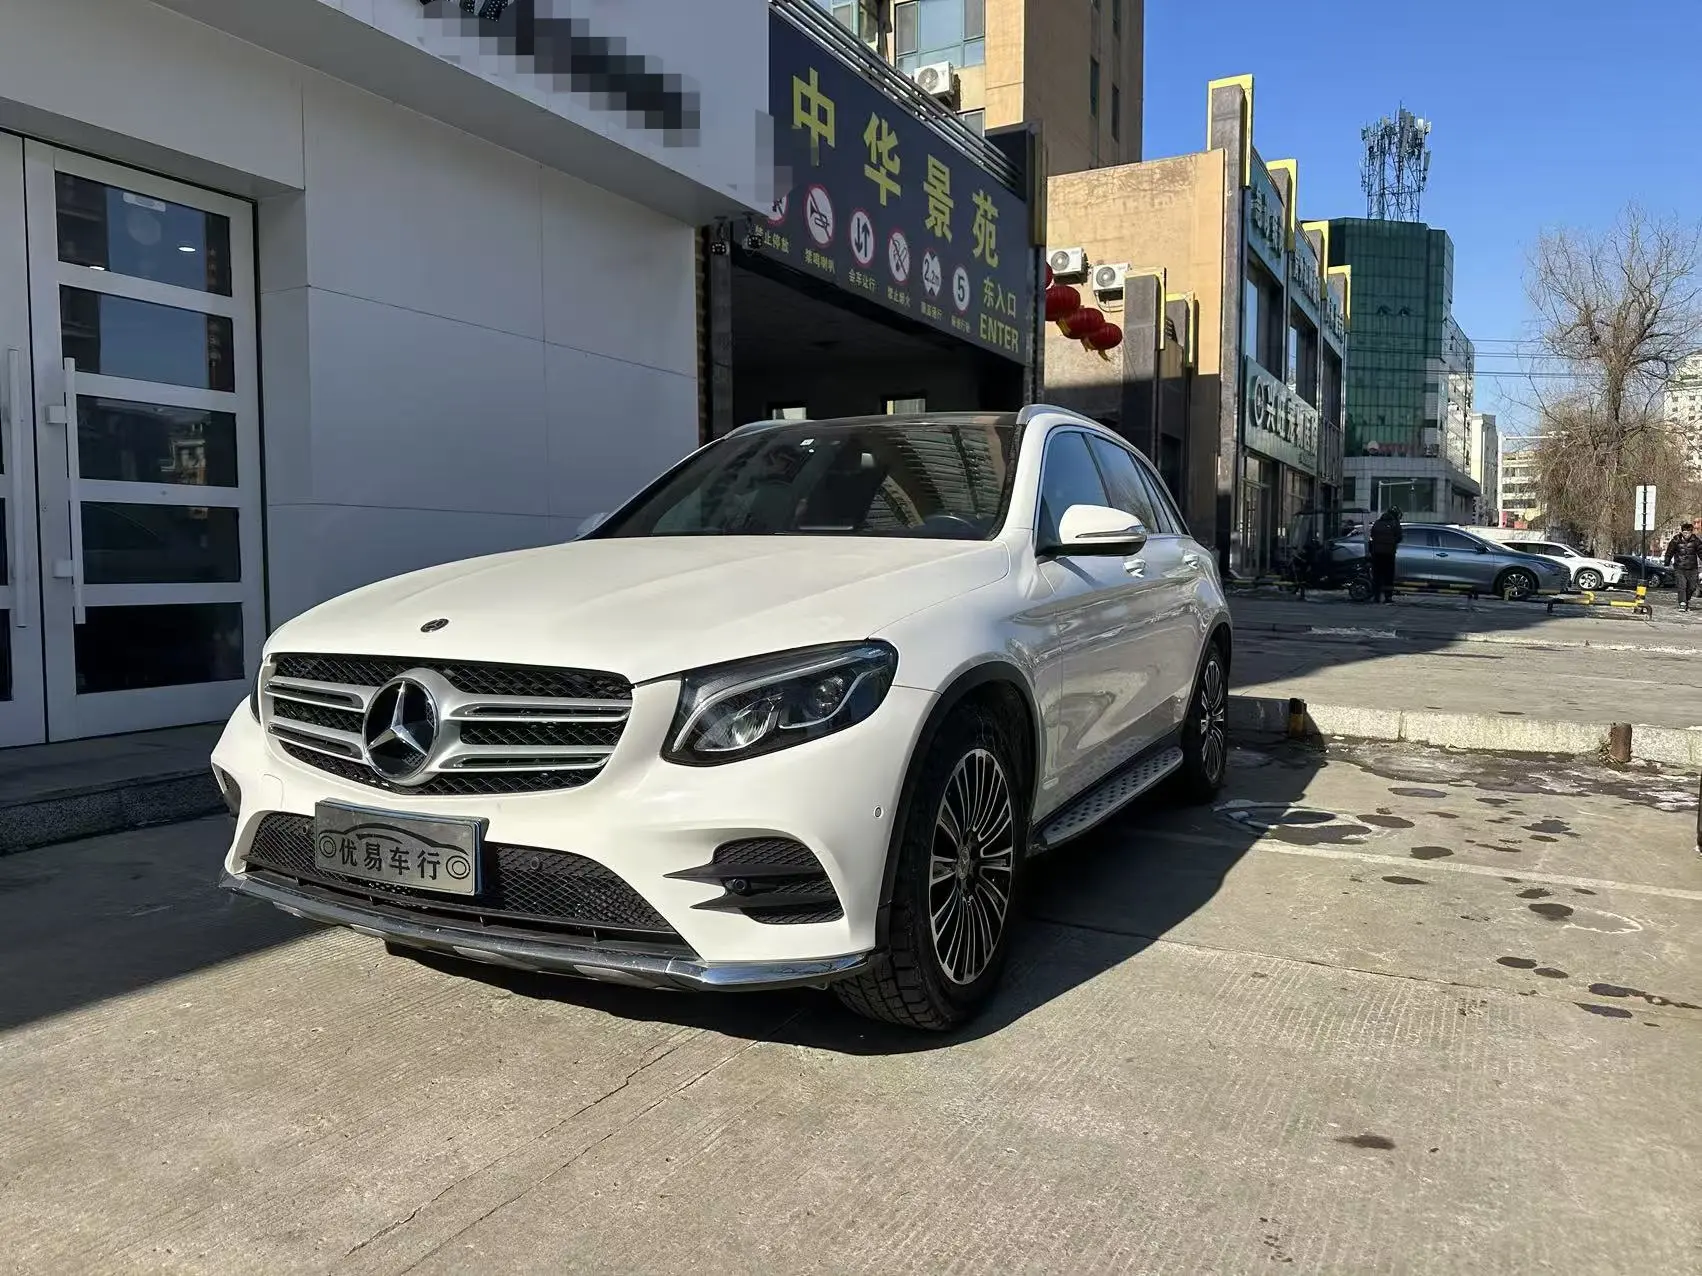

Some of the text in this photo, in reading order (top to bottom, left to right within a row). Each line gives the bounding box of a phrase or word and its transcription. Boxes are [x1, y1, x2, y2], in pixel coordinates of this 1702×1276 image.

[792, 67, 998, 268] 中华景苑
[957, 274, 966, 302] 5
[983, 276, 1017, 318] 东入口
[979, 313, 1019, 353] ENTER
[339, 837, 441, 880] 优易车行
